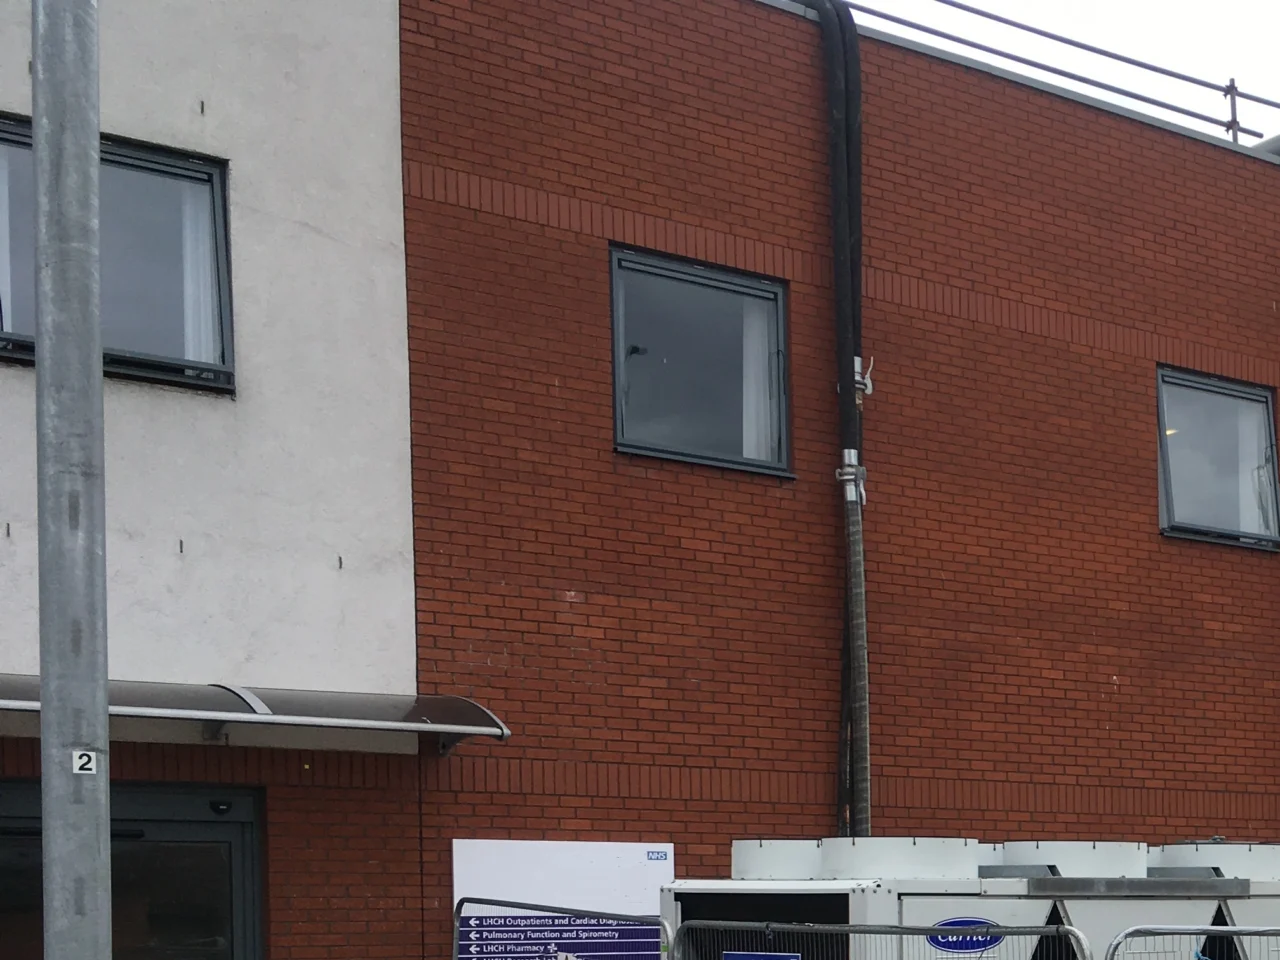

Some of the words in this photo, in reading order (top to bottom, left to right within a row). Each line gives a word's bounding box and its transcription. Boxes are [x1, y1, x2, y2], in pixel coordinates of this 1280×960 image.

[77, 753, 93, 771] 2
[648, 852, 666, 860] NHS
[506, 918, 552, 926] Outpatients
[554, 917, 568, 925] and
[570, 917, 598, 925] Cardiac
[482, 931, 525, 940] Pulmonary
[578, 930, 619, 939] Spirometry
[506, 945, 544, 953] Pharmacy
